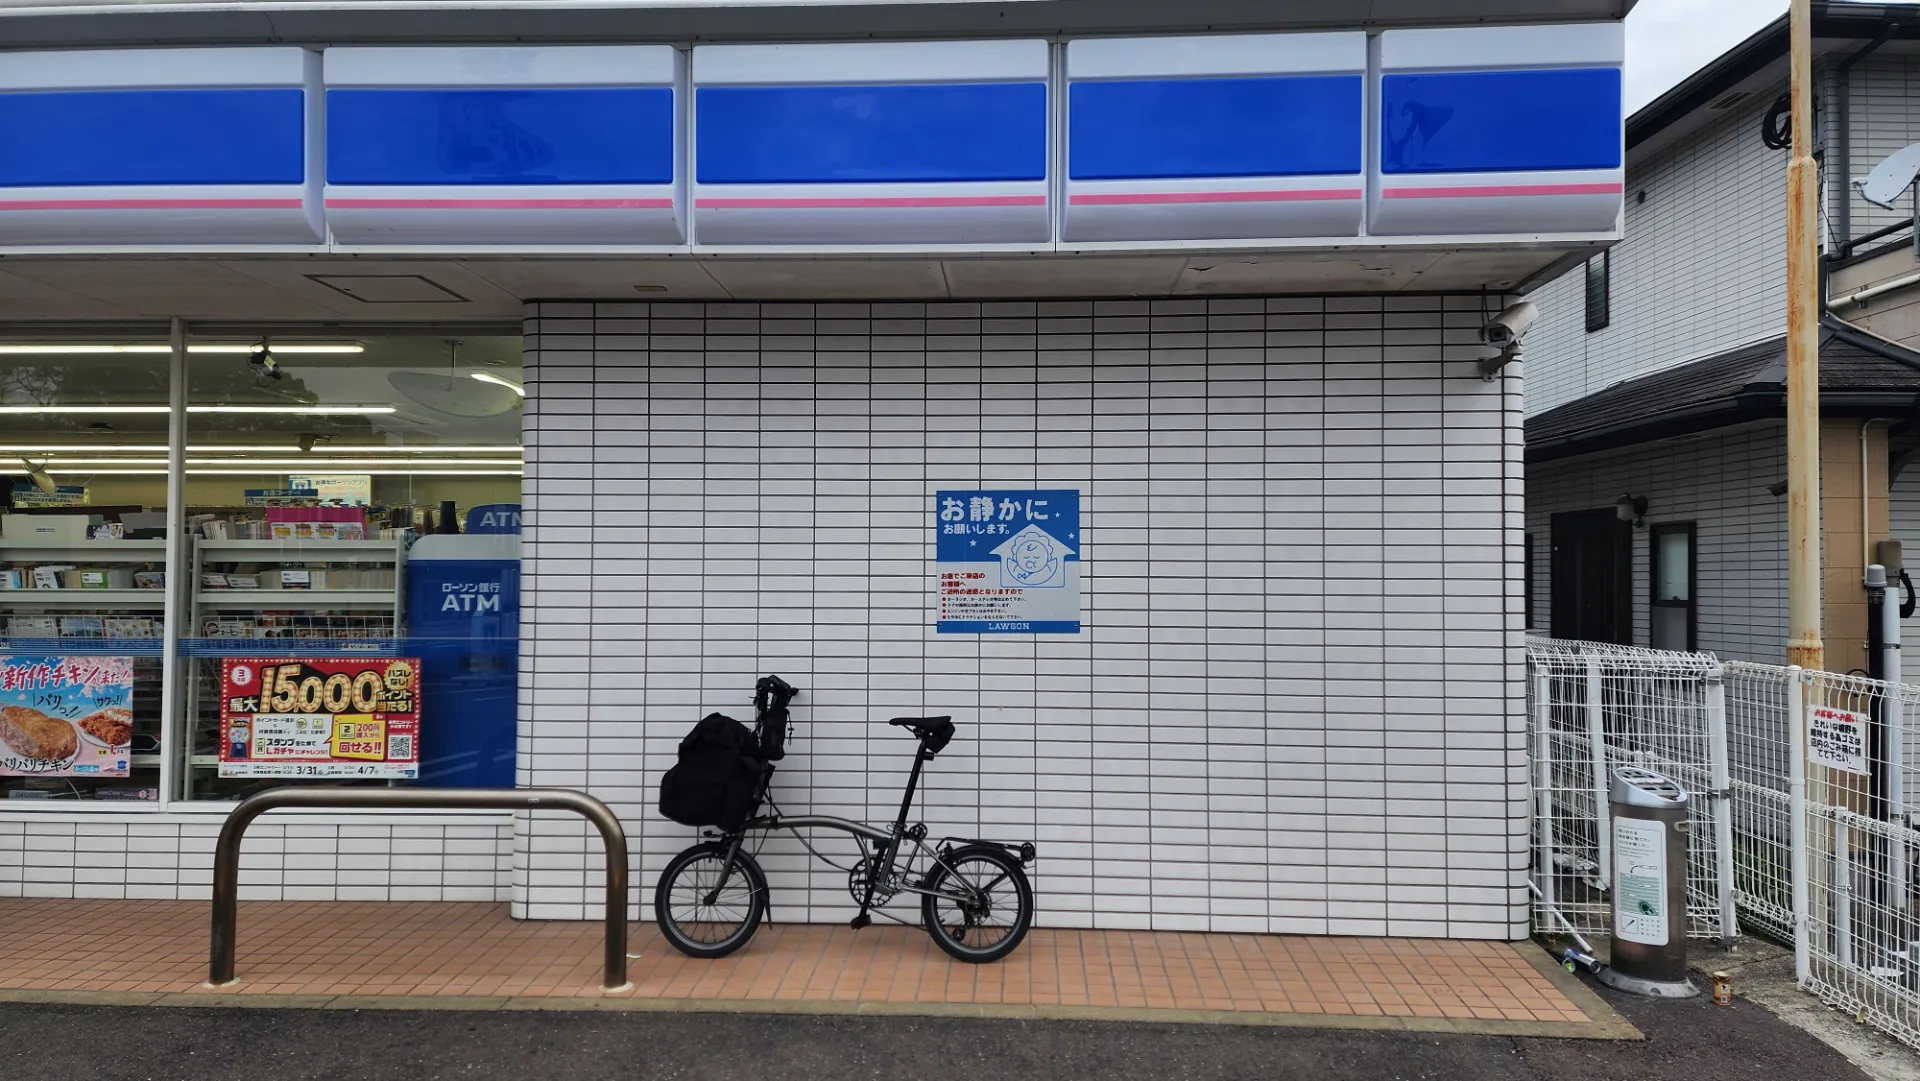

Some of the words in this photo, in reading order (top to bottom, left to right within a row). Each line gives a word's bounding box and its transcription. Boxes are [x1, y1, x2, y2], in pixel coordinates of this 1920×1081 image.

[940, 496, 1049, 522] お静かに
[943, 523, 1010, 535] お願いします。
[442, 582, 501, 593] ローソン銀行
[440, 594, 500, 612] ATM
[0, 664, 128, 690] 新作チキンが来た!
[238, 669, 245, 677] 3
[387, 670, 412, 678] ハズレ
[390, 678, 409, 687] なし!
[229, 696, 258, 713] 最大
[260, 664, 384, 713] 15,000
[376, 690, 412, 701] ポイント
[376, 700, 413, 712] 当たる!
[357, 723, 380, 732] 200円
[266, 738, 295, 746] スタンプ
[339, 742, 382, 754] 回せる!!
